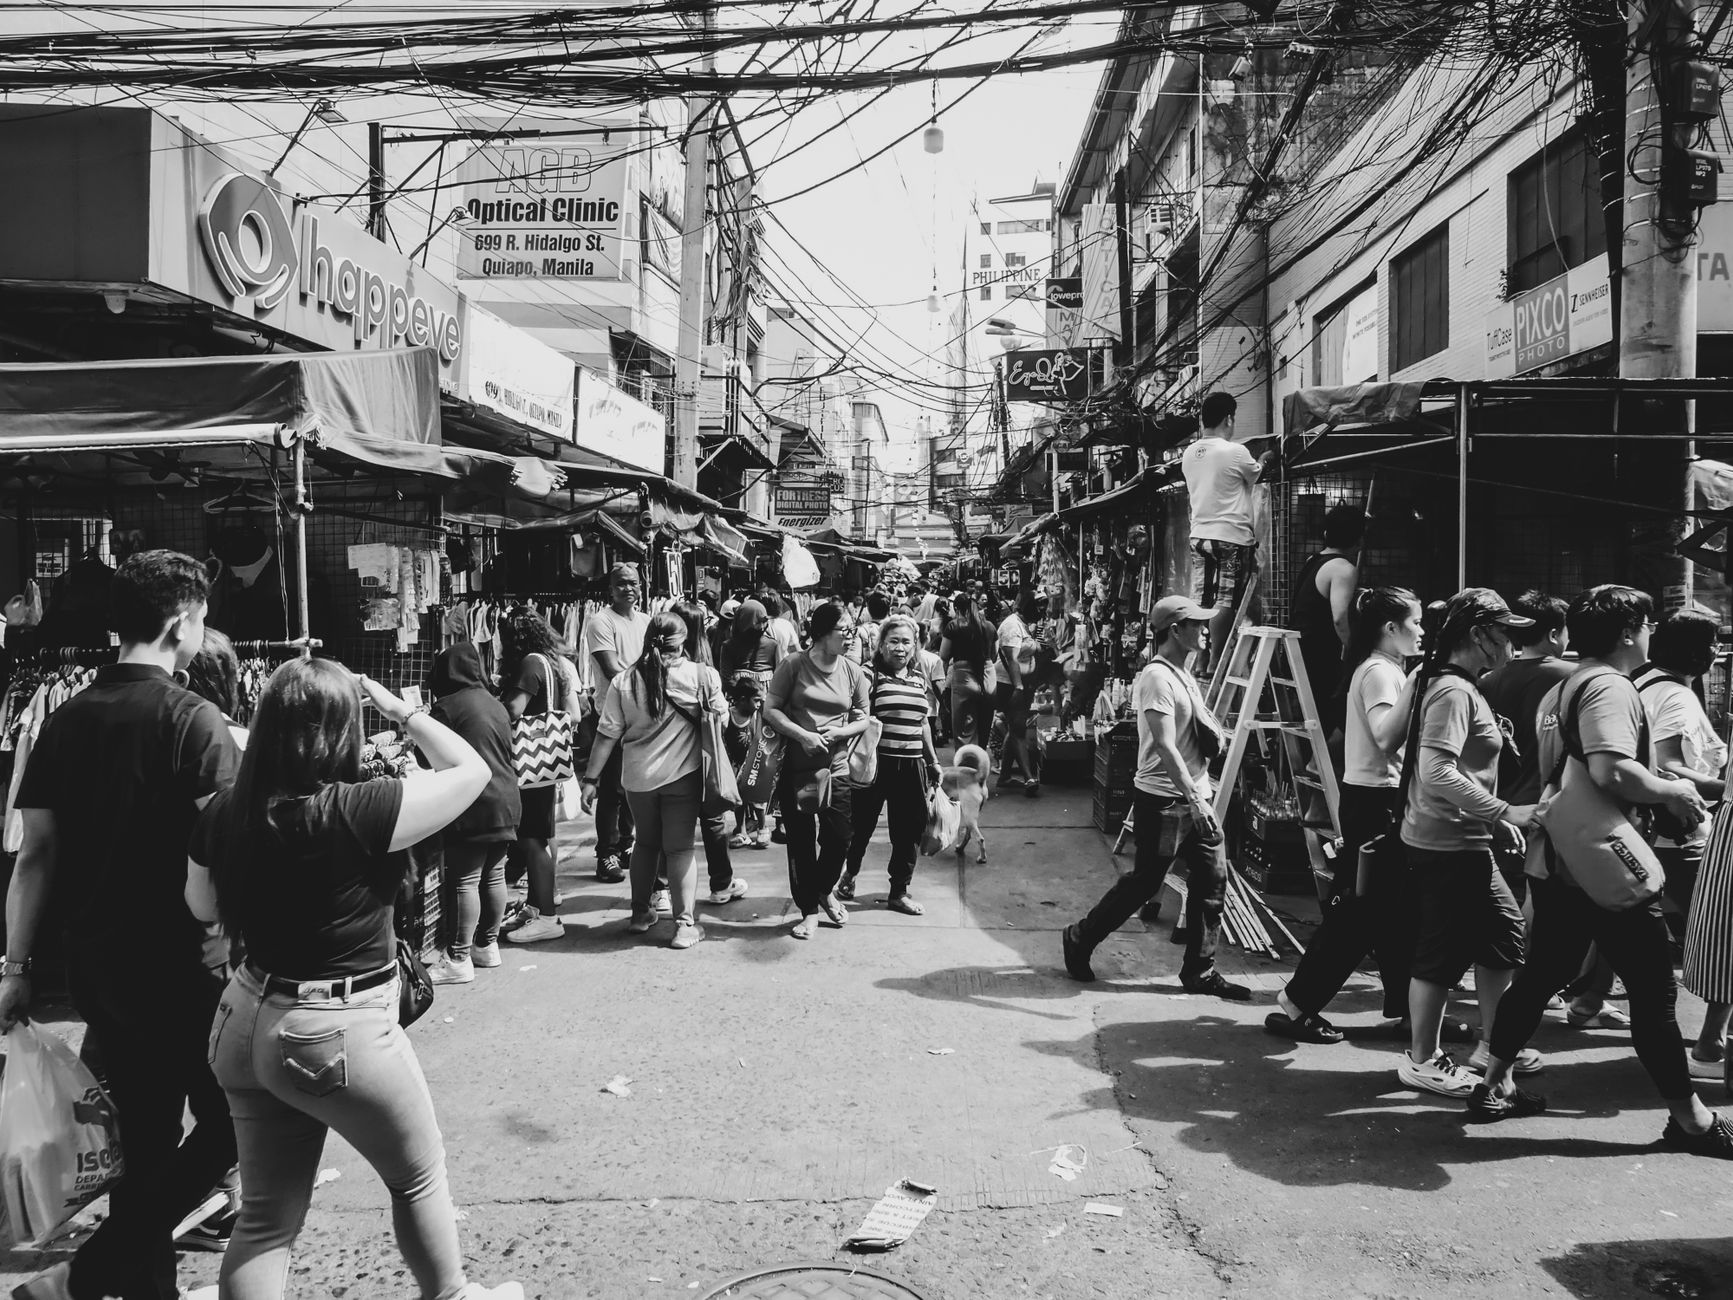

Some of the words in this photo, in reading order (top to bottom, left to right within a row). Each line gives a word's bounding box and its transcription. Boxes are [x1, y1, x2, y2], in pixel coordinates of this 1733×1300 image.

[495, 148, 591, 193] AGB
[467, 198, 547, 225] Optical
[552, 197, 619, 222] Clinic
[474, 234, 501, 251] 699
[505, 234, 520, 251] R.
[524, 234, 581, 253] Hidalgo
[585, 234, 605, 251] St.
[482, 257, 537, 277] Quiapo,
[542, 258, 594, 276] Manila
[972, 268, 1041, 285] PHILIPPINE
[300, 213, 461, 362] happeve
[1516, 286, 1566, 349] PIXCO
[1518, 336, 1565, 365] PHOTO
[776, 489, 829, 501] FORTRESS
[776, 501, 803, 509] DIGITAL
[804, 501, 828, 509] PHOTO
[778, 515, 827, 528] Energizer
[752, 738, 768, 769] STORE
[747, 769, 759, 786] SM
